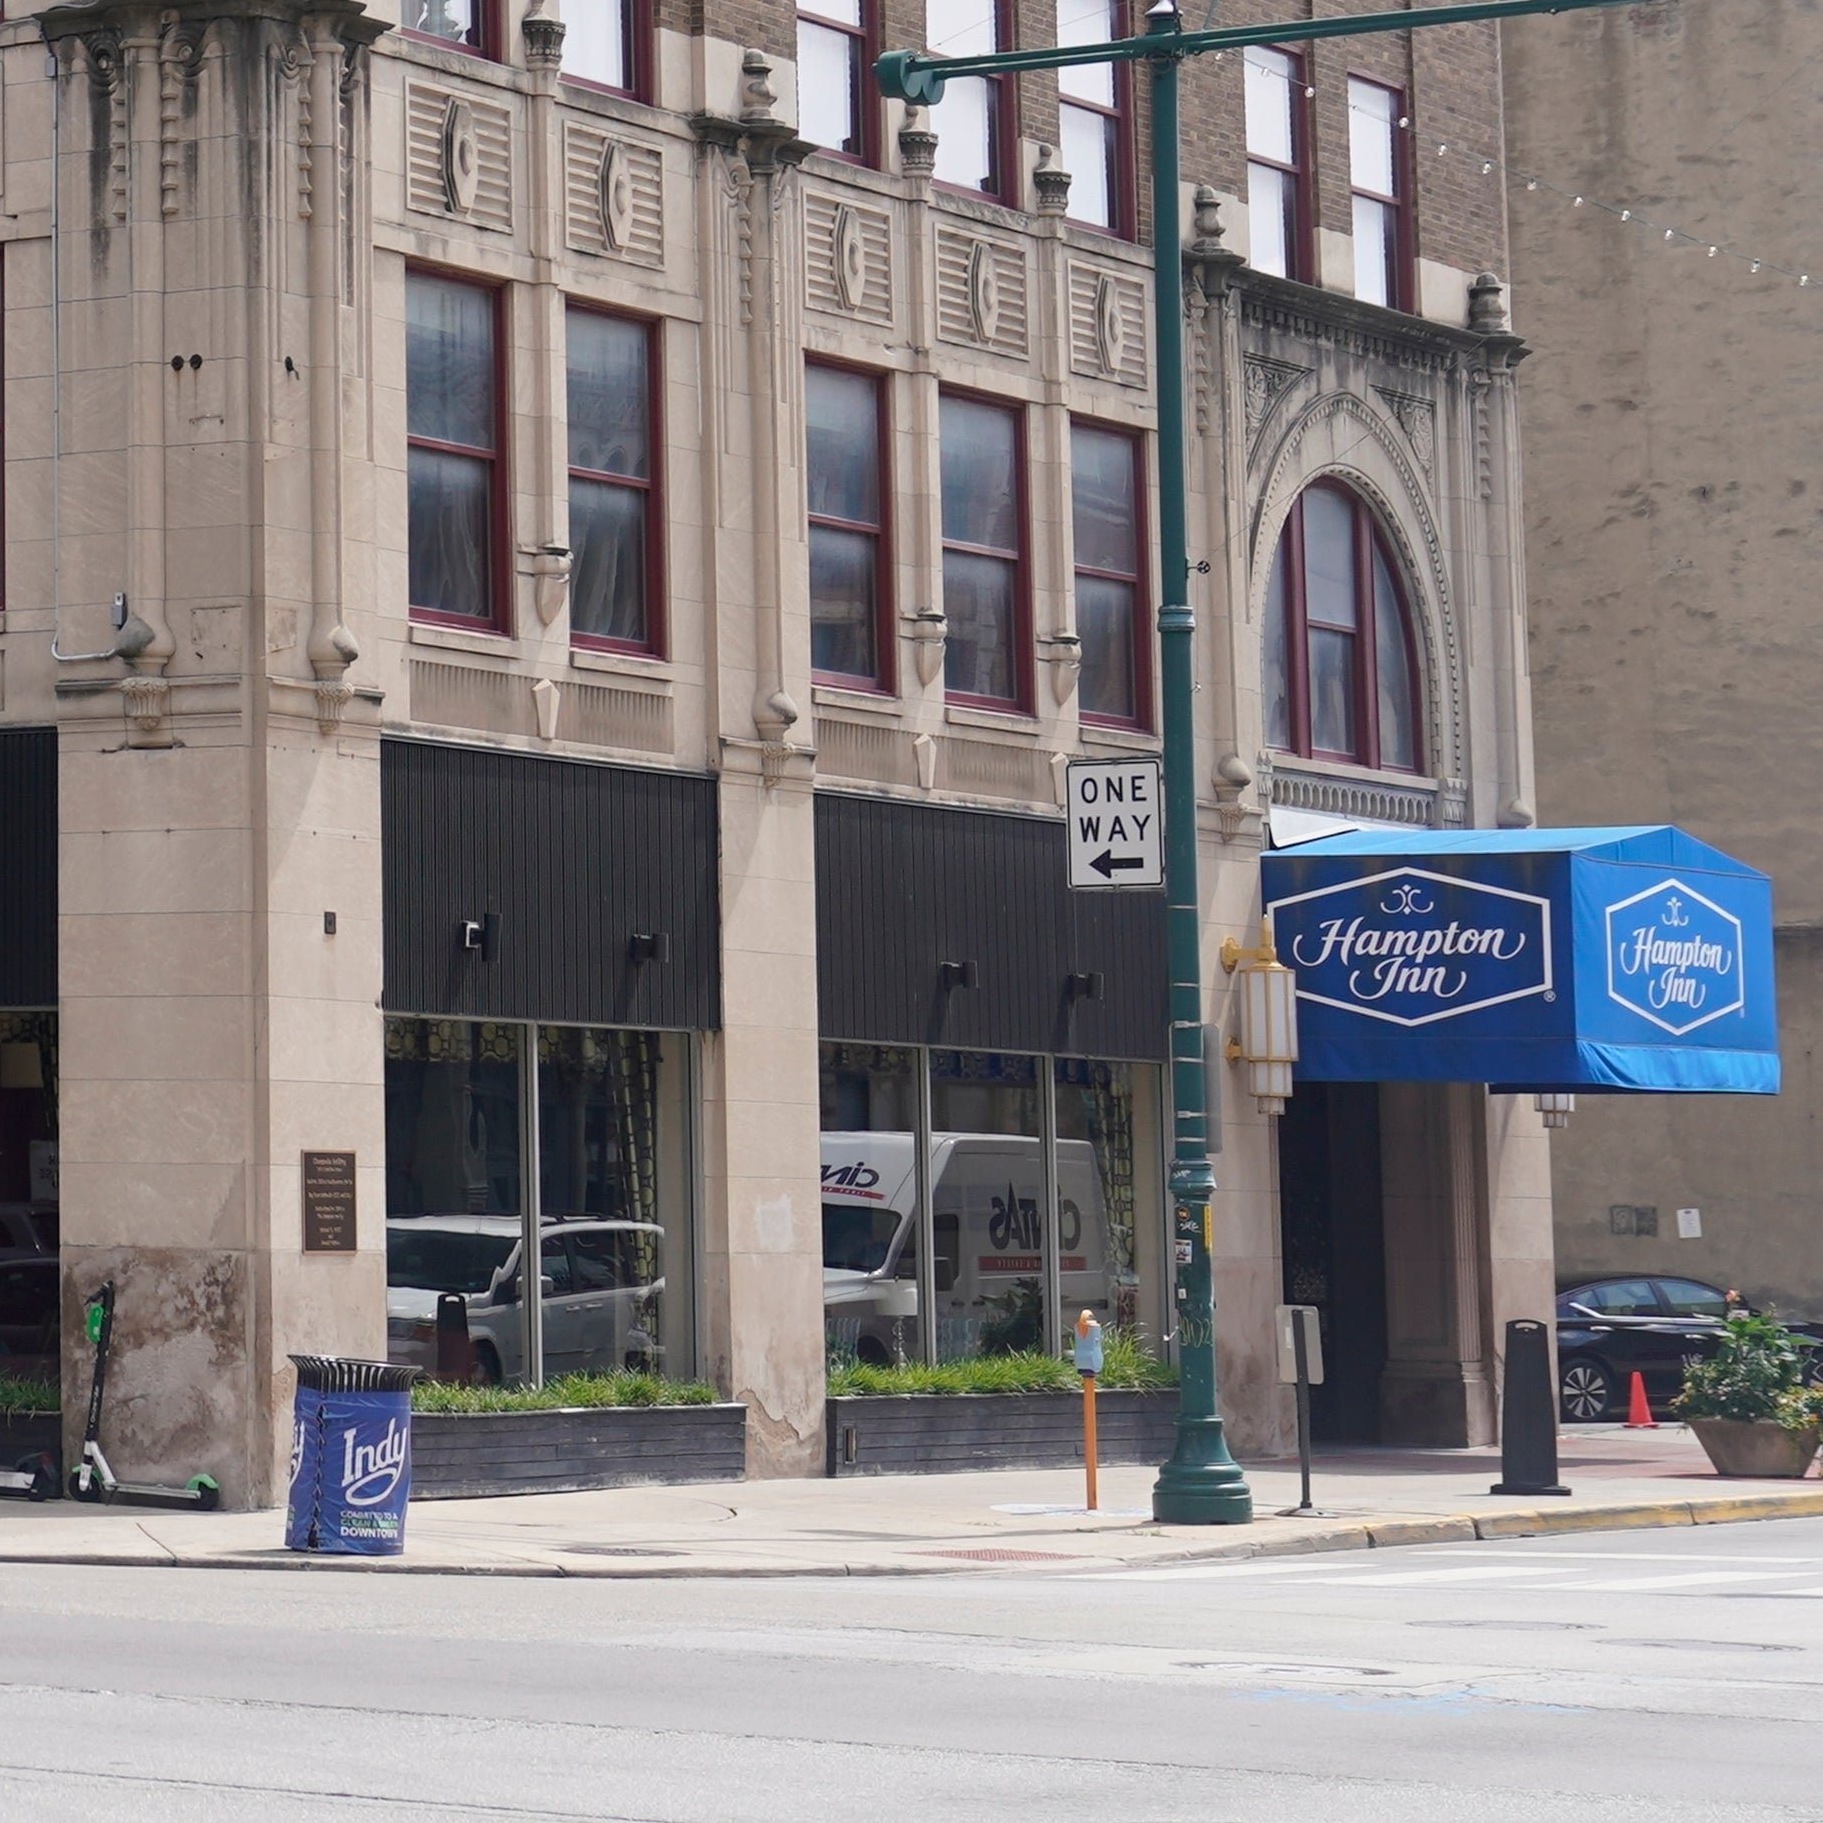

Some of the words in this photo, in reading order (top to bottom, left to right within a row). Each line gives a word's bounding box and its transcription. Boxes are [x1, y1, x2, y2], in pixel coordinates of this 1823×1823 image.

[1081, 775, 1147, 804] ONE
[1079, 814, 1152, 843] WAY
[1292, 916, 1526, 967] Hampton
[1620, 925, 1732, 975] Hampton
[1349, 956, 1467, 1000] Inn
[1648, 966, 1706, 1009] Inn
[341, 1417, 407, 1506] Indy
[340, 1526, 398, 1539] DOWNTOWN
